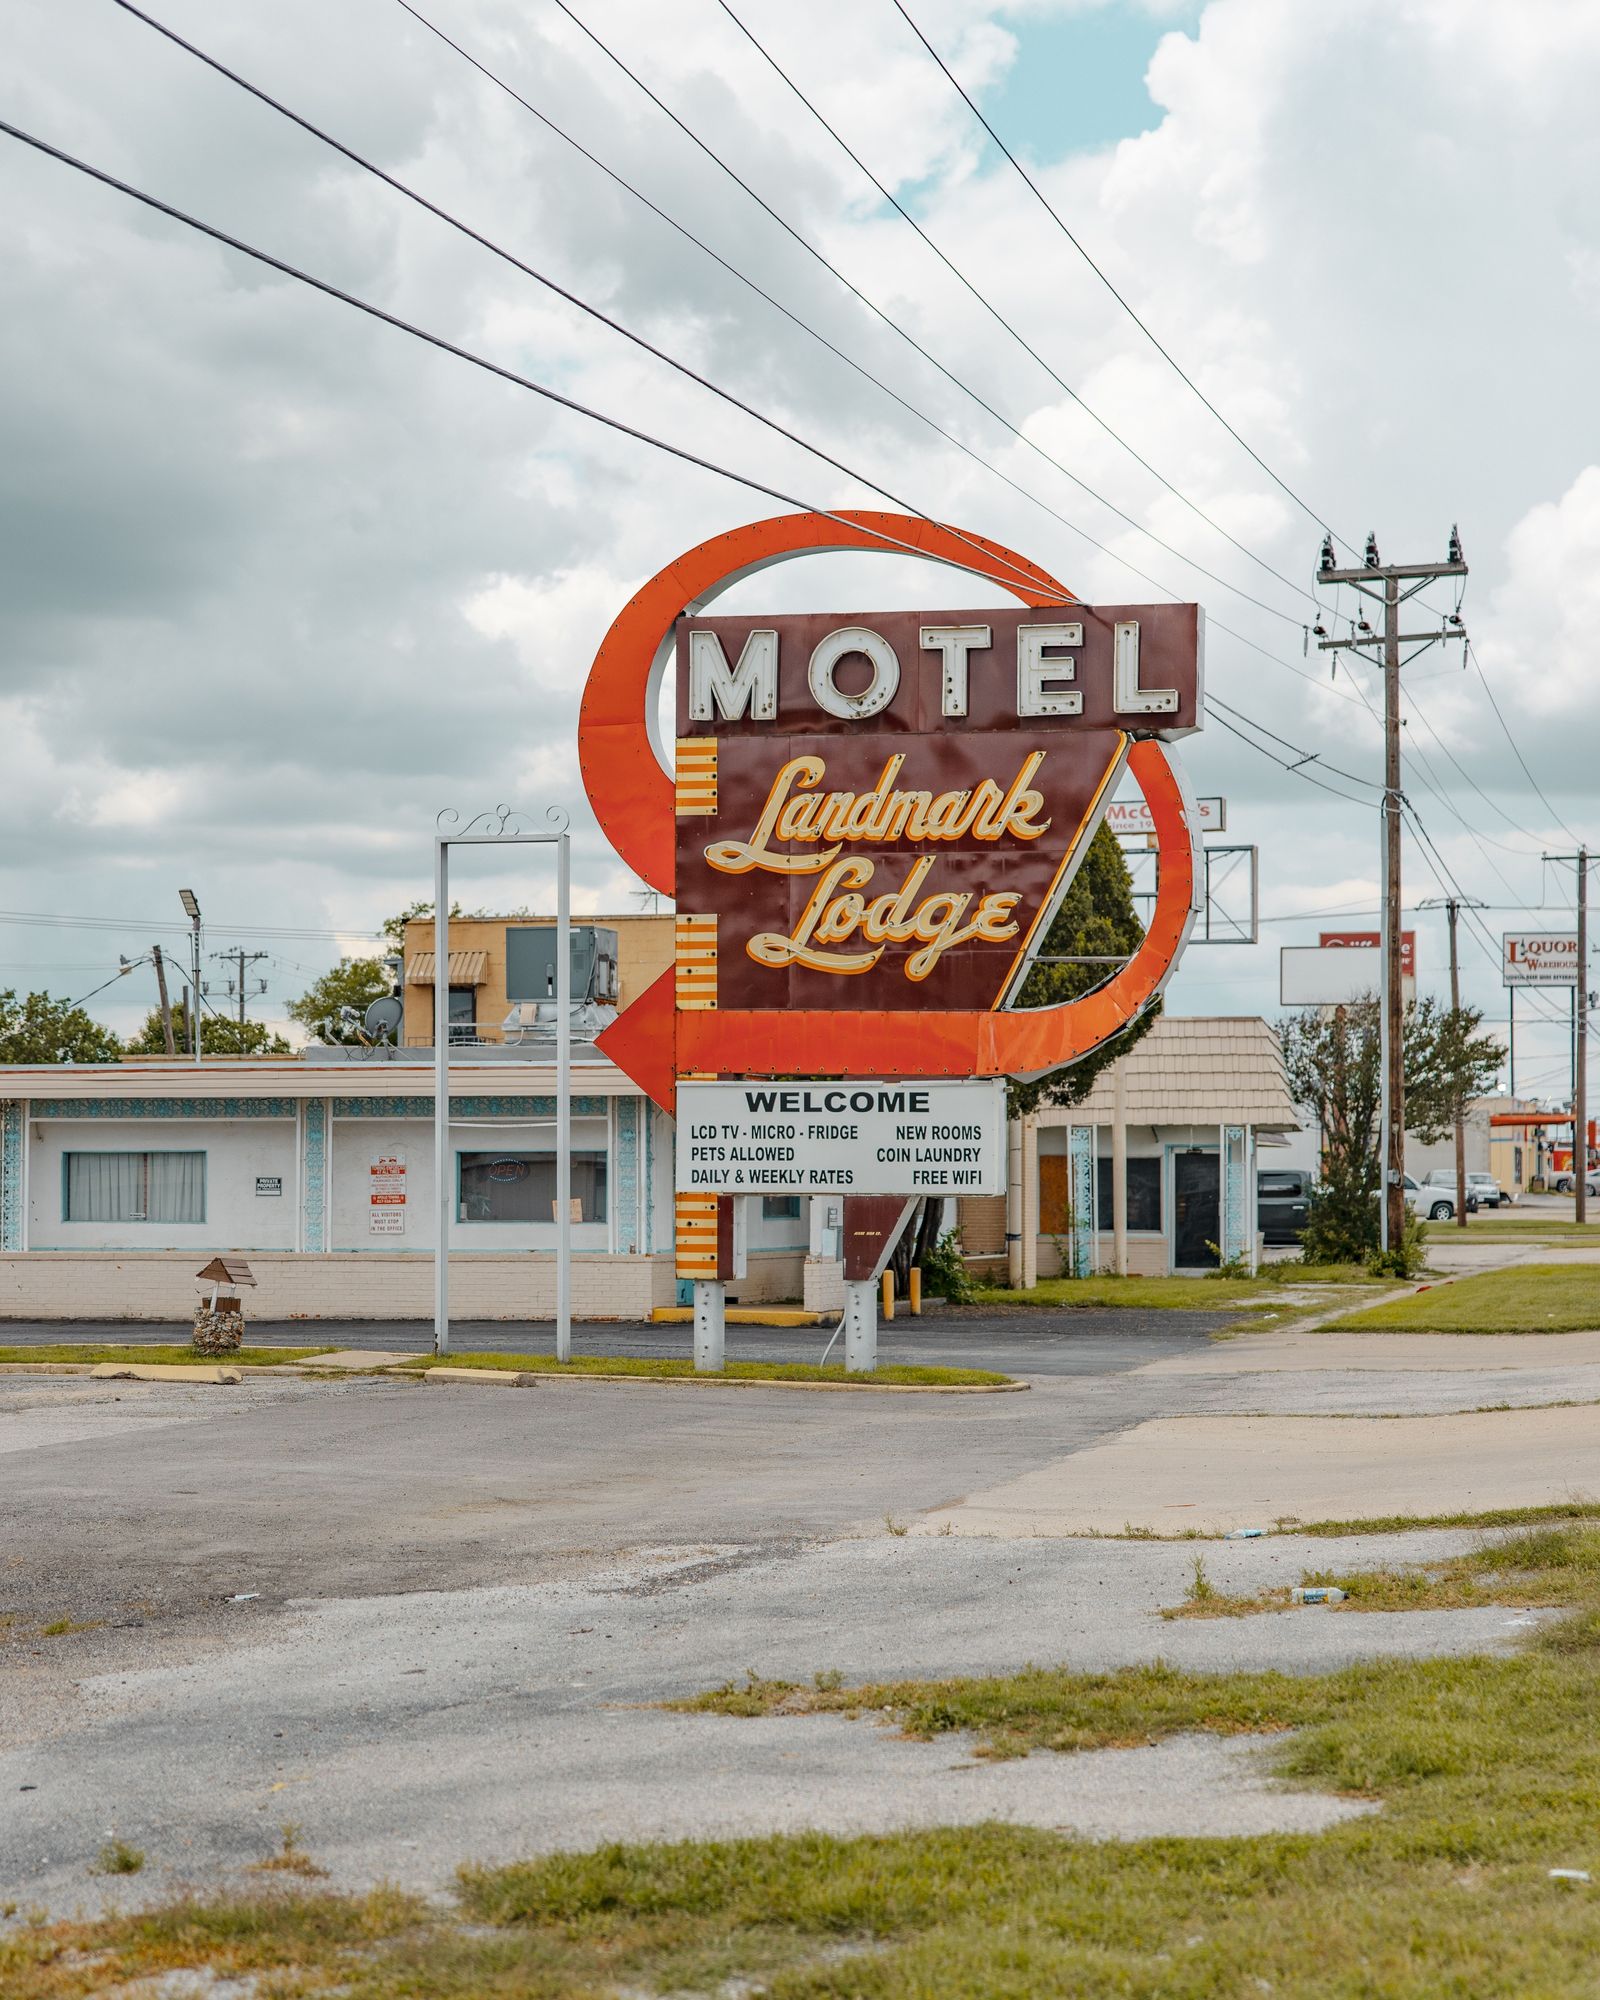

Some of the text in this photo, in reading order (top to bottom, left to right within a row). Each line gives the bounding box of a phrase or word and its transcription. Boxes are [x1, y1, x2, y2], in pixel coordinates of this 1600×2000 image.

[688, 620, 1180, 721] MOTEL
[704, 751, 1052, 875] Landmark
[746, 855, 1024, 982] Lodge
[745, 1091, 930, 1113] WELCOME
[691, 1125, 717, 1140] LCD
[721, 1125, 740, 1140] TV
[751, 1125, 796, 1140] MICRO
[808, 1125, 859, 1140] FRIDGE
[896, 1125, 982, 1141] NEW ROOMS
[691, 1147, 795, 1162] PETS ALLOWED
[876, 1147, 982, 1163] COIN LAUNDRY
[490, 1165, 524, 1176] OPEN
[691, 1169, 854, 1184] DAILY & WEEKLY RATES
[913, 1170, 982, 1185] FREE WIFI
